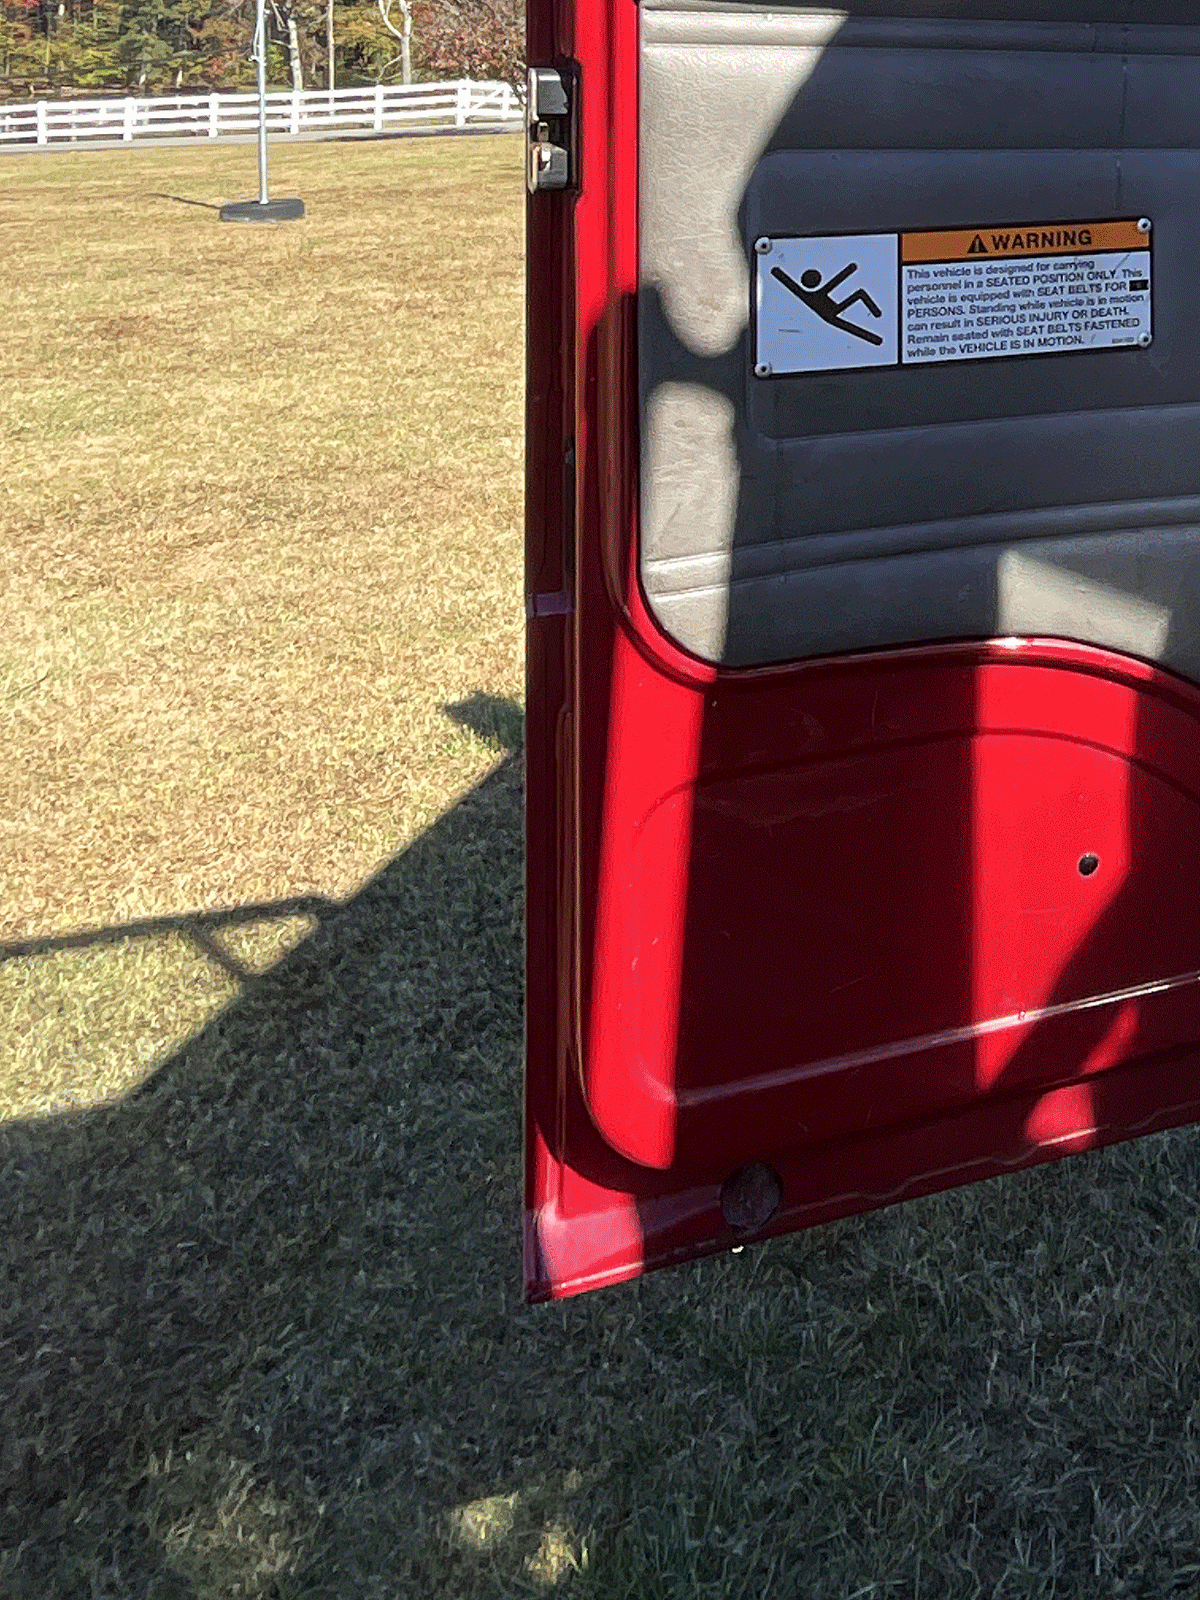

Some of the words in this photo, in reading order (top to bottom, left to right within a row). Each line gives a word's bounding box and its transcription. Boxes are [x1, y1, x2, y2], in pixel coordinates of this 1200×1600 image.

[991, 229, 1092, 250] WARNING
[907, 269, 930, 279] This
[932, 267, 971, 278] vehicle
[974, 266, 982, 275] is
[986, 263, 1034, 276] designed
[1036, 262, 1050, 271] for
[1053, 260, 1095, 270] carrying
[907, 280, 962, 294] personnel
[964, 280, 974, 288] in
[986, 276, 1030, 287] SEATED
[1033, 272, 1084, 284] POSITION
[1122, 268, 1142, 278] This
[907, 294, 946, 305] vehicle
[948, 293, 958, 302] is
[960, 290, 1010, 302] equipped
[1012, 289, 1034, 298] with
[1037, 286, 1065, 296] SEAT
[1068, 284, 1102, 294] BELTS
[1105, 282, 1127, 292] FOR
[907, 306, 966, 318] PERSONS.
[968, 304, 1016, 314] Standing
[1018, 300, 1046, 310] while
[1048, 297, 1084, 308] vehicle
[1086, 296, 1096, 306] is
[1098, 296, 1108, 304] in
[1110, 294, 1144, 304] motion
[907, 322, 928, 332] can
[930, 318, 962, 330] result
[964, 318, 974, 328] in
[976, 314, 1026, 326] SERIOUS
[1029, 310, 1070, 322] INJURY
[1072, 310, 1088, 319] OR
[907, 334, 950, 344] Remain
[952, 329, 988, 341] seated
[991, 327, 1014, 338] with
[1016, 324, 1046, 336] SEAT
[1048, 322, 1082, 334] BELTS
[1084, 318, 1140, 331] FASTENED
[907, 347, 936, 358] while
[938, 346, 957, 355] the
[958, 340, 1008, 354] VEHICLE
[1010, 340, 1022, 350] IS
[1022, 338, 1035, 348] IN
[1038, 336, 1084, 346] MOTION.
